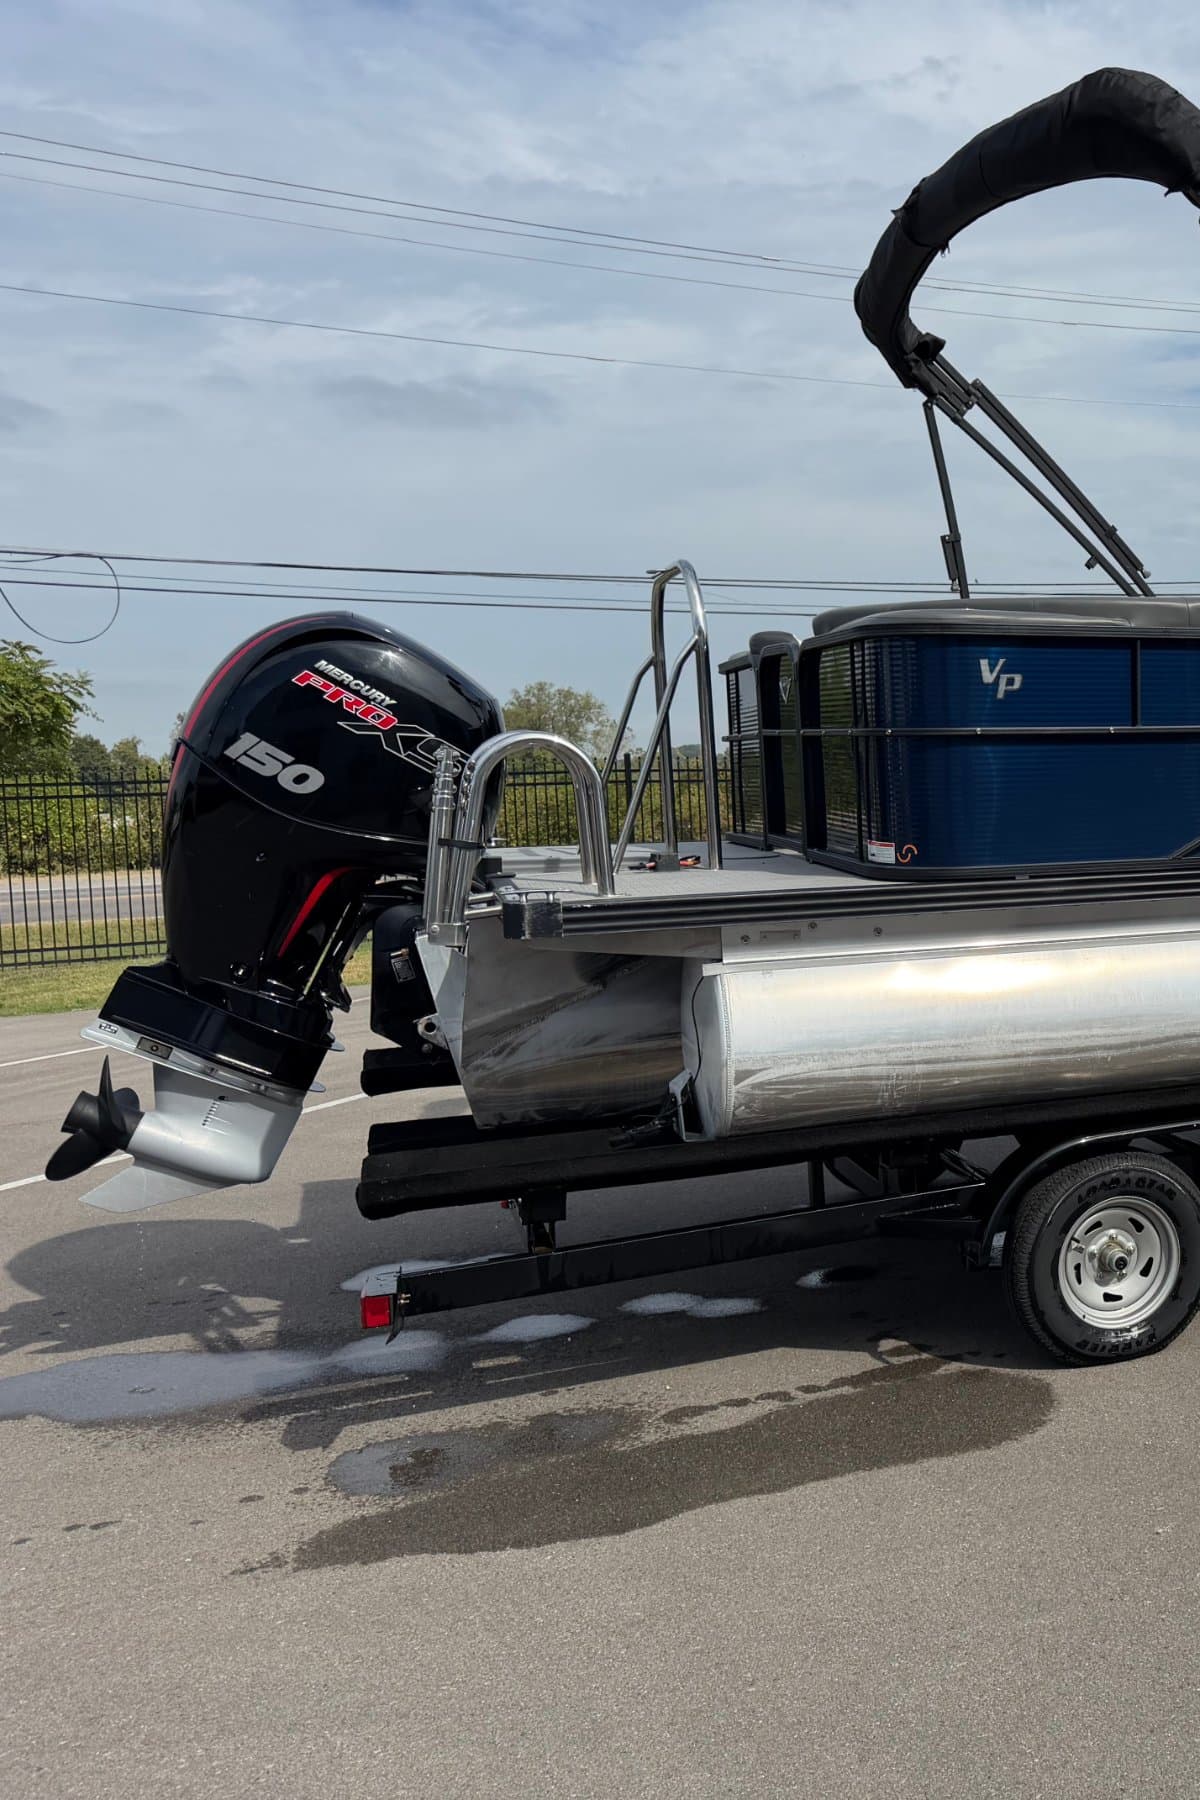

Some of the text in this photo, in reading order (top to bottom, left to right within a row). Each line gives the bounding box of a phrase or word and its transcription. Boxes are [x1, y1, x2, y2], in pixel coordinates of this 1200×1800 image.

[292, 670, 398, 730] PRO
[314, 660, 397, 707] MERCURY
[223, 732, 325, 795] 150
